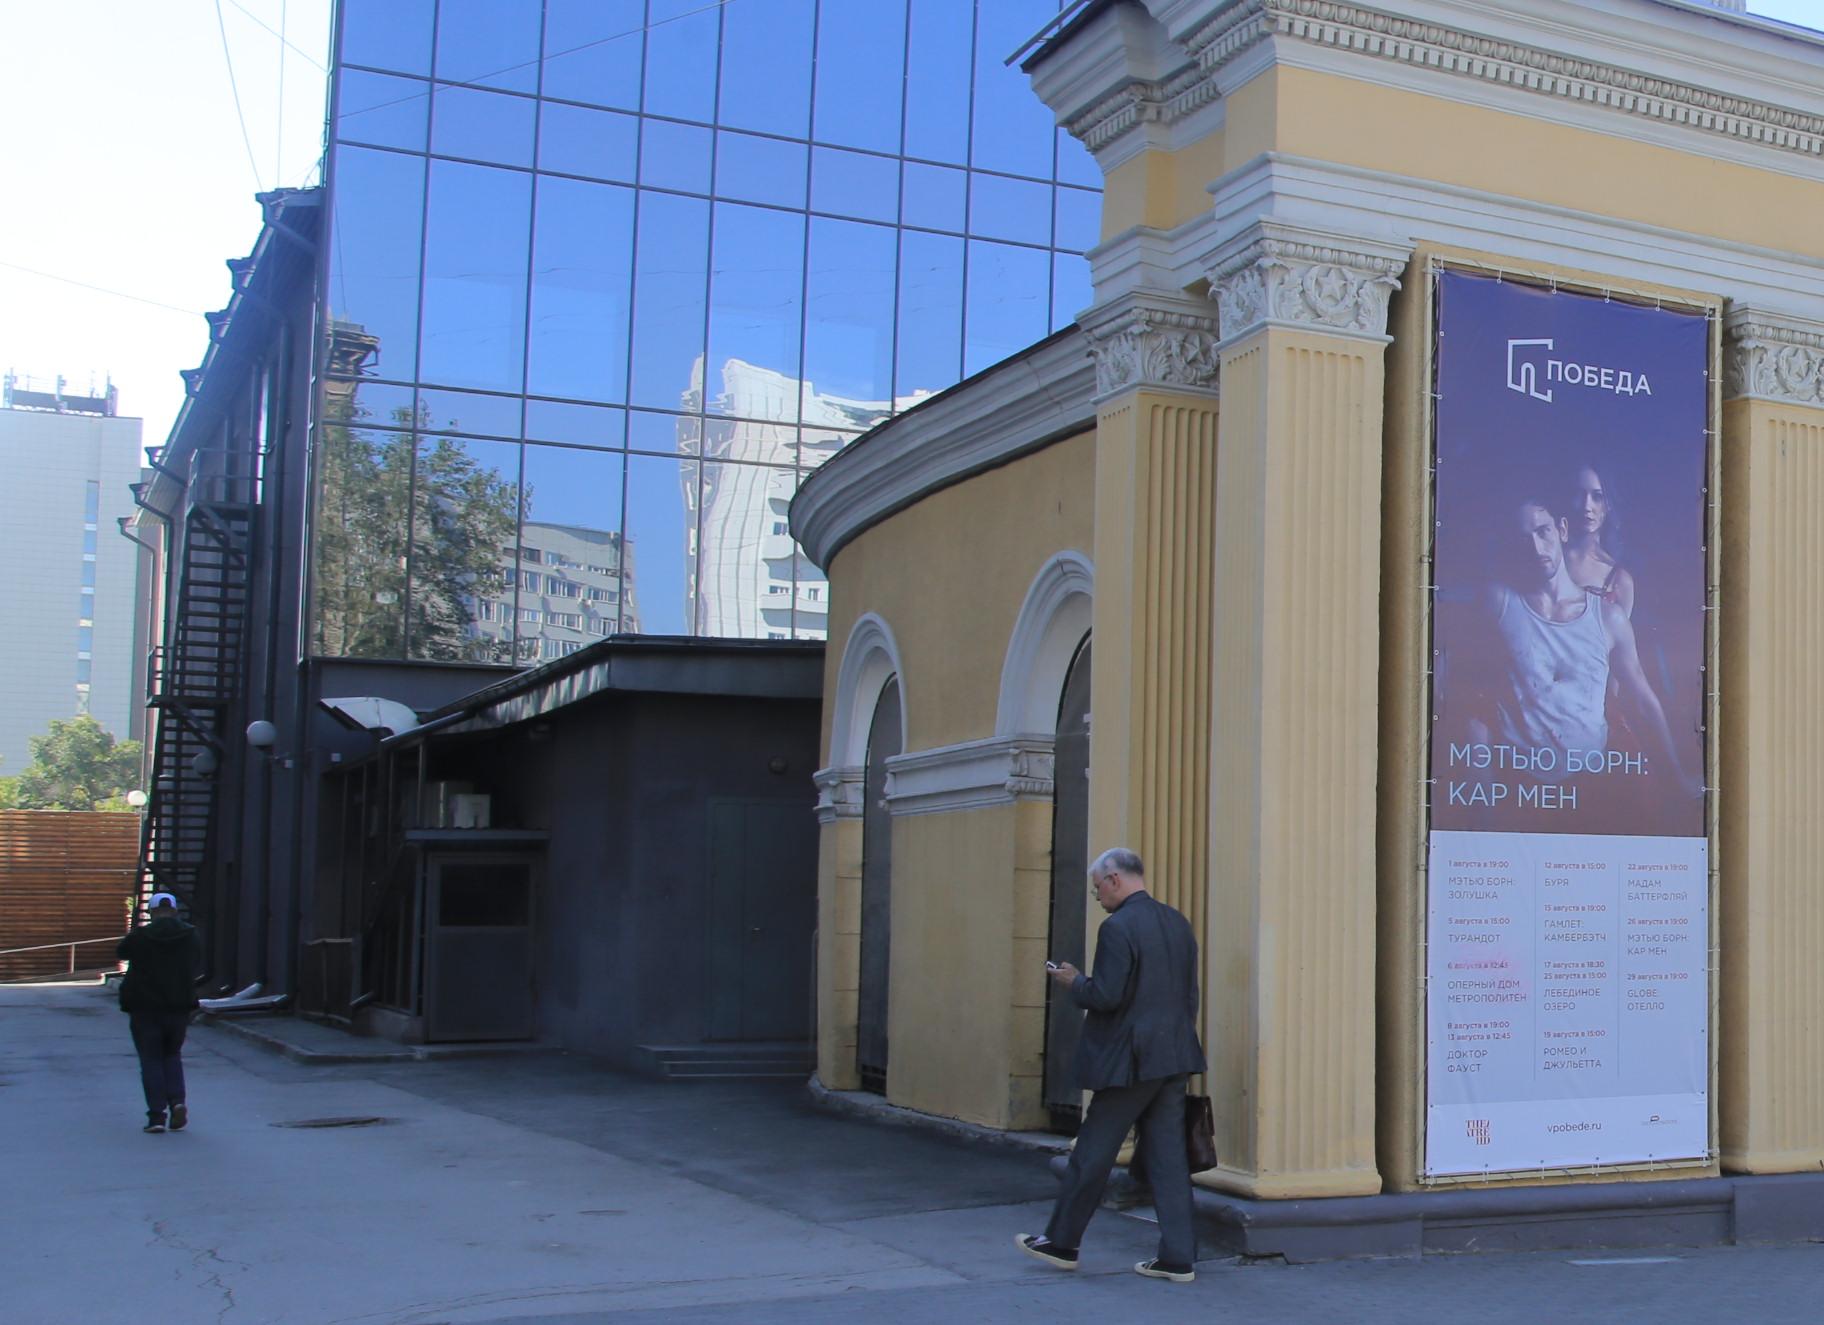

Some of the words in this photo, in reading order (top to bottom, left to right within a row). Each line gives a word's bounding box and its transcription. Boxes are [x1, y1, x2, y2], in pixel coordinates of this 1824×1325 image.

[1547, 359, 1651, 396] ПОБЕДА
[1450, 743, 1556, 771] МЭТЬЮ
[1566, 749, 1649, 775] БОРН:
[1449, 781, 1508, 807] КАР
[1518, 784, 1577, 809] МЕН
[1448, 877, 1484, 886] МЭТЬЮ
[1544, 878, 1569, 887] БУРЯ
[1627, 880, 1662, 888] МАДАМ
[1448, 890, 1498, 900] ЗОЛУШКА
[1628, 892, 1688, 900] БАТТЕРФЛЯЙ
[1454, 918, 1482, 926] августа
[1448, 934, 1501, 943] ТУРАНДОТ
[1544, 933, 1606, 941] КАМБЕРБЭТЧ
[1628, 934, 1660, 942] МЭТЬЮ
[1628, 947, 1646, 955] КАР
[1648, 947, 1667, 955] МЕН
[1448, 979, 1496, 989] ОПЕРНЫЙ
[1497, 980, 1520, 990] ДОМ
[1544, 988, 1600, 998] ЛЕБЕДИНОЕ
[1627, 989, 1657, 997] GLOBE
[1448, 994, 1527, 1002] МЕТРОПОЛИТЕН
[1544, 1002, 1576, 1011] ОЗЕРО
[1627, 1002, 1665, 1011] ОТЕЛЛО
[1448, 1050, 1488, 1060] ДОКТОР
[1544, 1047, 1577, 1056] РОМЕО
[1448, 1064, 1481, 1072] ФАУСТ
[1544, 1060, 1602, 1070] ДЖУЛЬЕТТА
[1547, 1122, 1602, 1134] vpobede.ru
